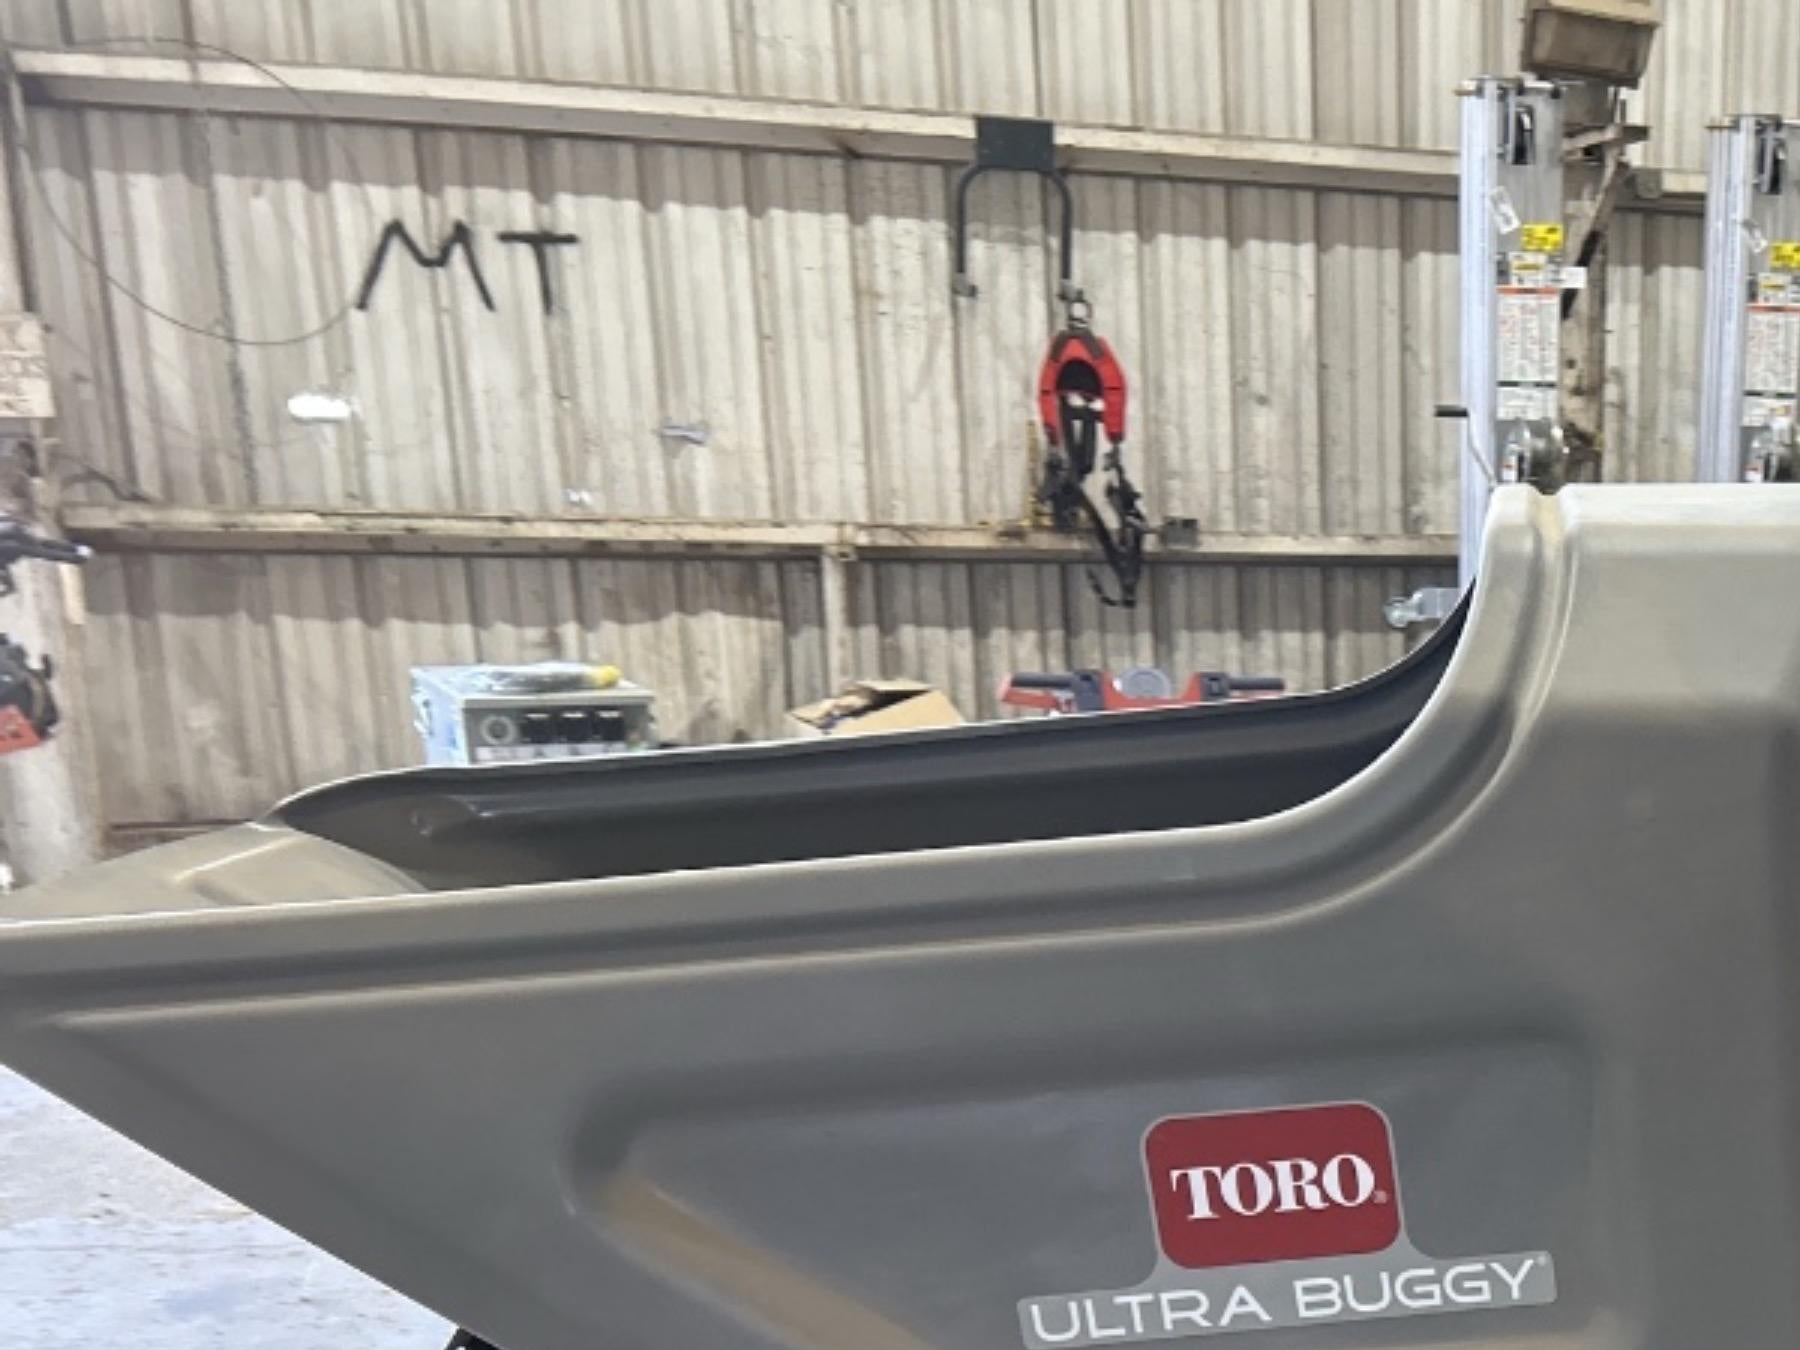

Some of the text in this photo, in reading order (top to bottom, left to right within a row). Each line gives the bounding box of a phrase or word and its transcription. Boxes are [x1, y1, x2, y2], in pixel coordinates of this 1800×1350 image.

[355, 218, 577, 315] MT
[1170, 1154, 1376, 1220] TORO
[1028, 1258, 1535, 1343] ULTRA BUGGY
